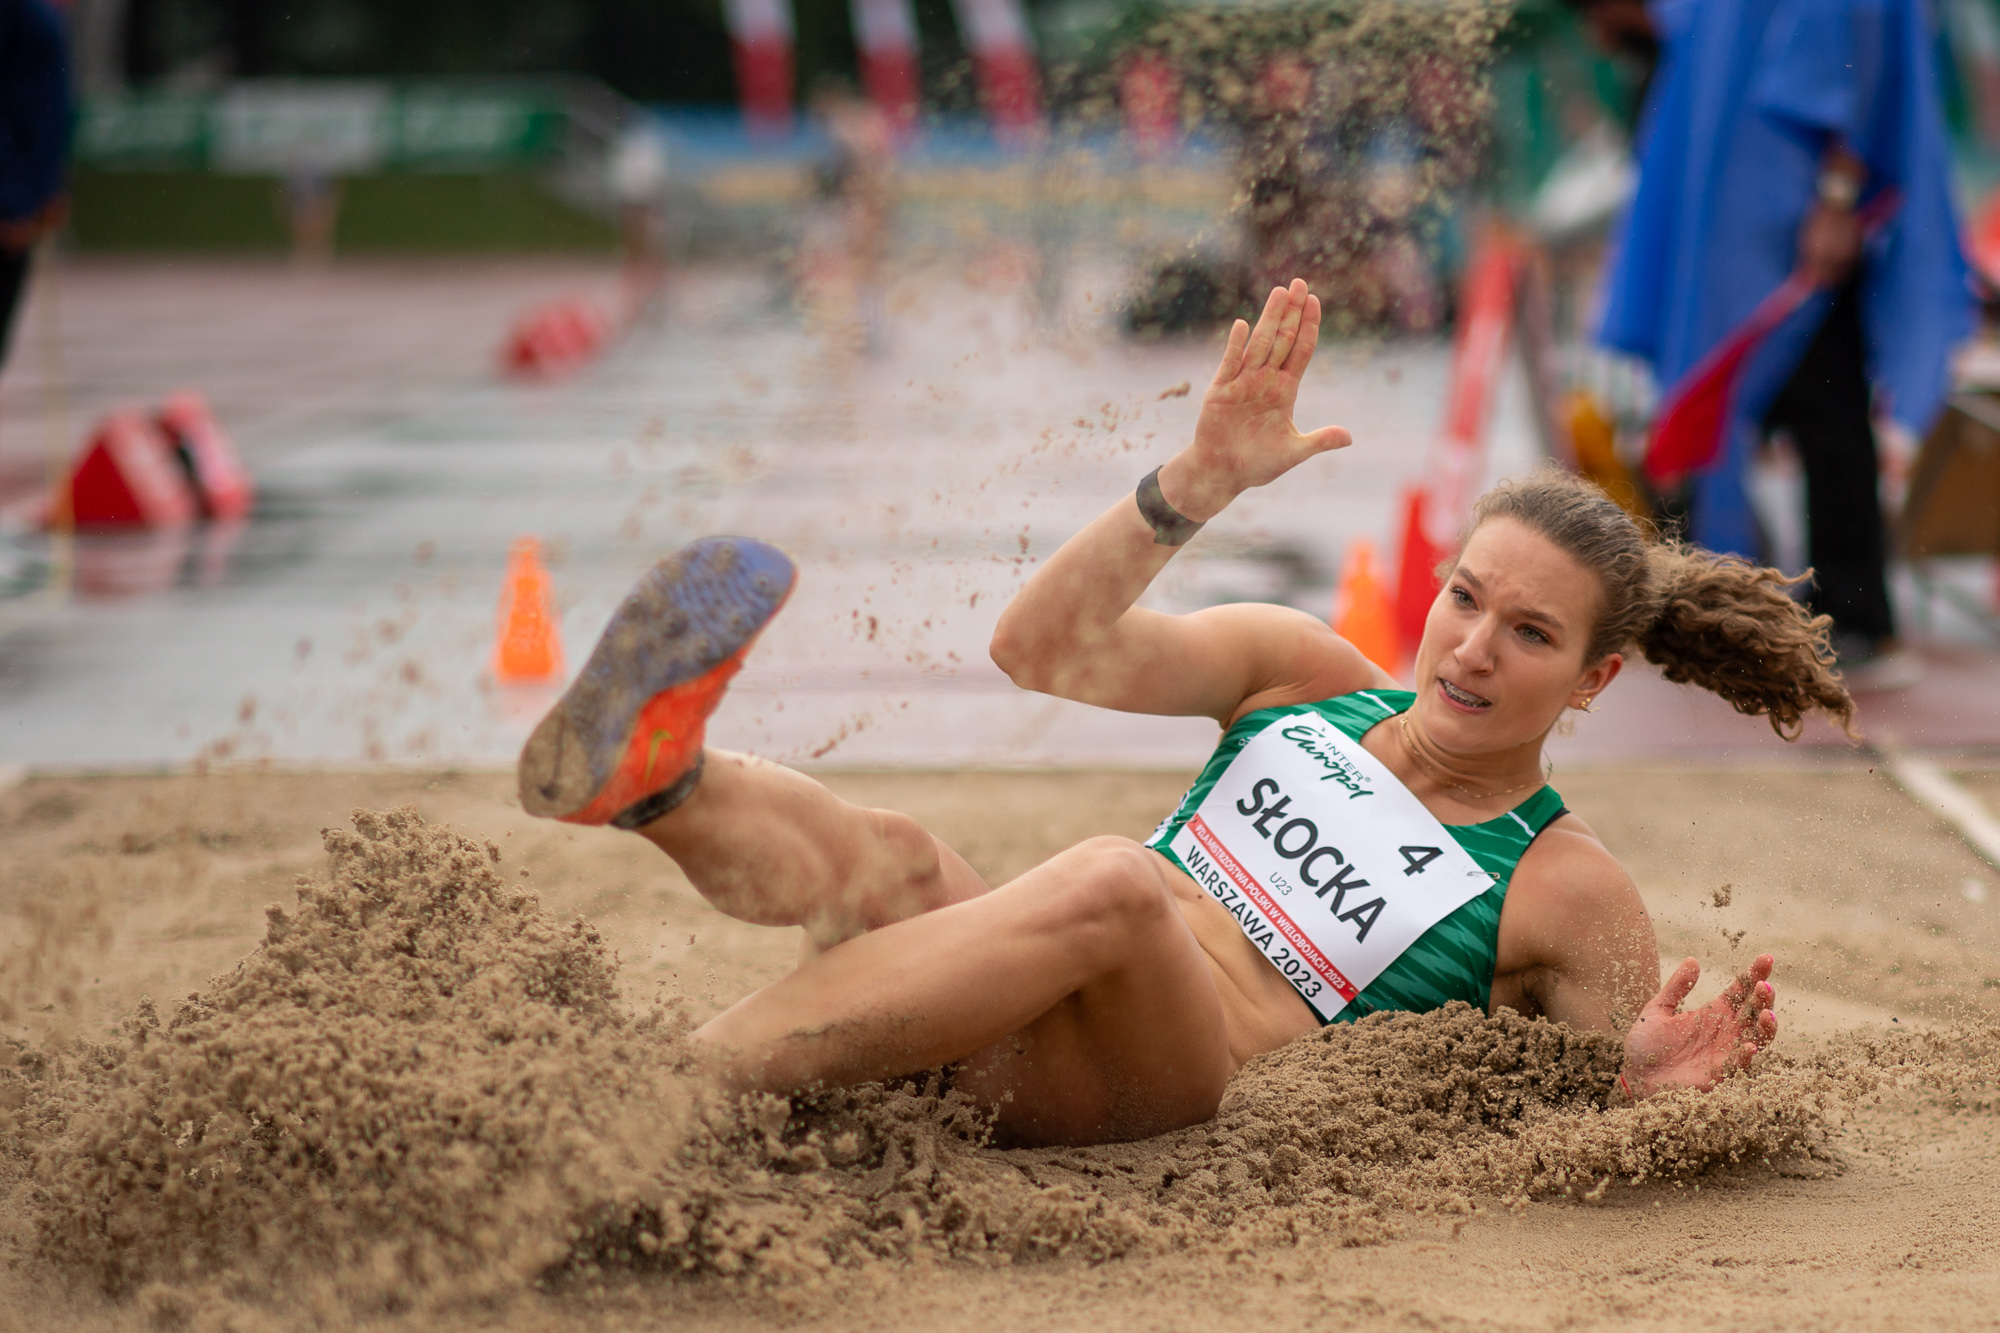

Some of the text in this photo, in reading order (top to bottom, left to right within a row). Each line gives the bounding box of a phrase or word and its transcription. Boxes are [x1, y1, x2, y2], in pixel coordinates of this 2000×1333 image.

[1281, 725, 1374, 800] Europol
[1324, 742, 1364, 782] INTER
[1236, 778, 1388, 945] SŁOCKA
[1269, 871, 1293, 896] U23
[1397, 844, 1444, 878] 4
[1186, 844, 1323, 999] WARSZAWA 2023
[1194, 824, 1347, 990] PZLA MISTRZOSTWA POLSKI W WIELOBOJACH 2023
